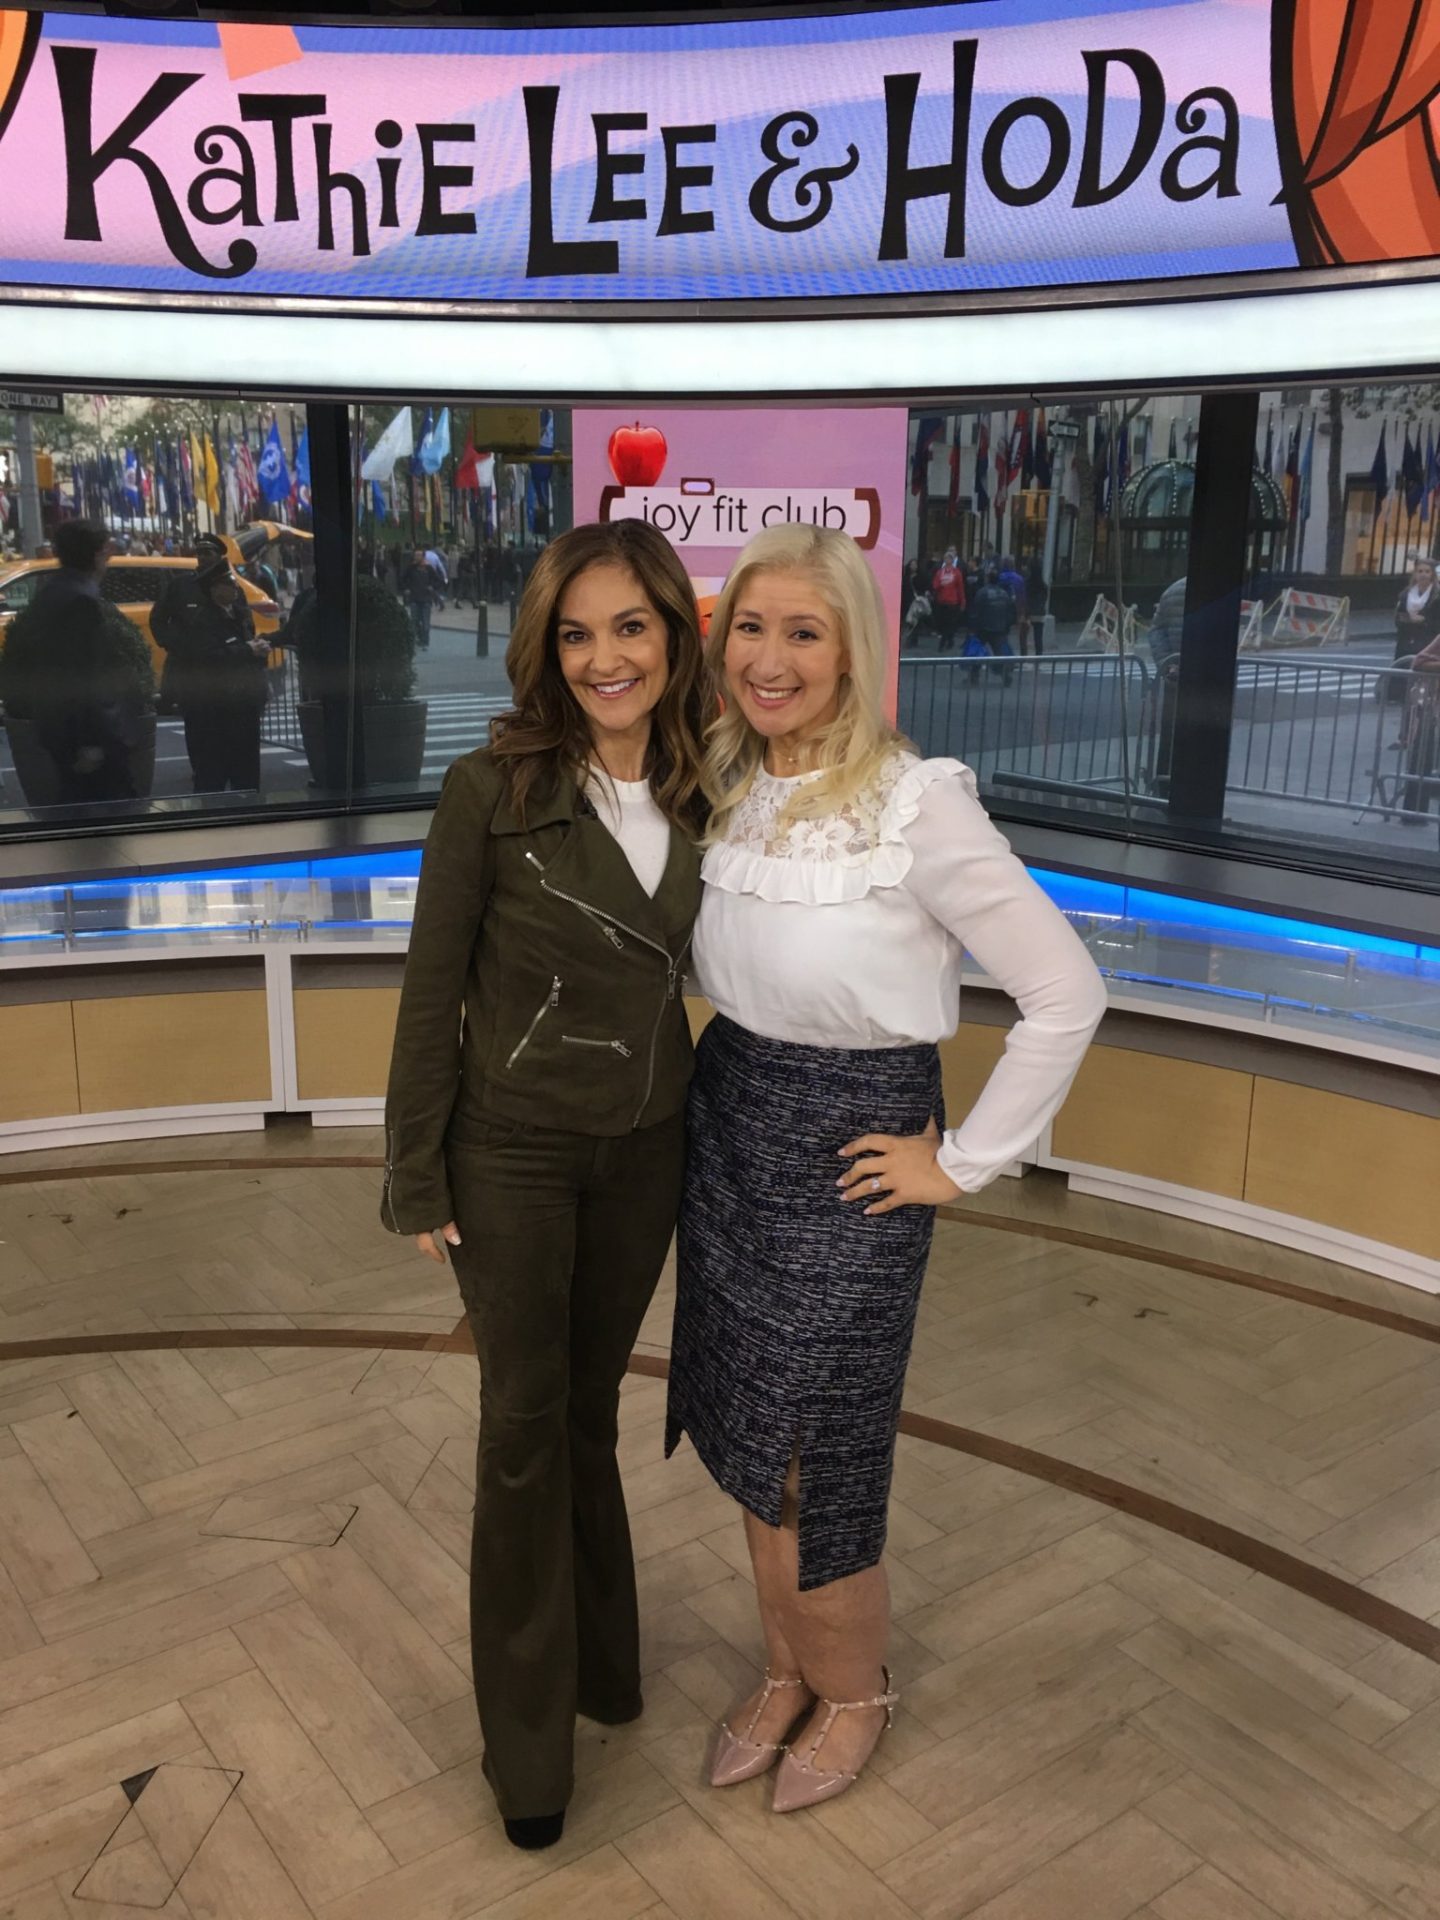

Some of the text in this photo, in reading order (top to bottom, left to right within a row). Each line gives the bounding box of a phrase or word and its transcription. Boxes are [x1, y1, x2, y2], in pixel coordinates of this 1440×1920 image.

[522, 85, 717, 278] LEE
[748, 110, 860, 233] &
[1, 392, 53, 407] ONE WAY
[713, 495, 748, 533] fit
[761, 495, 847, 531] club
